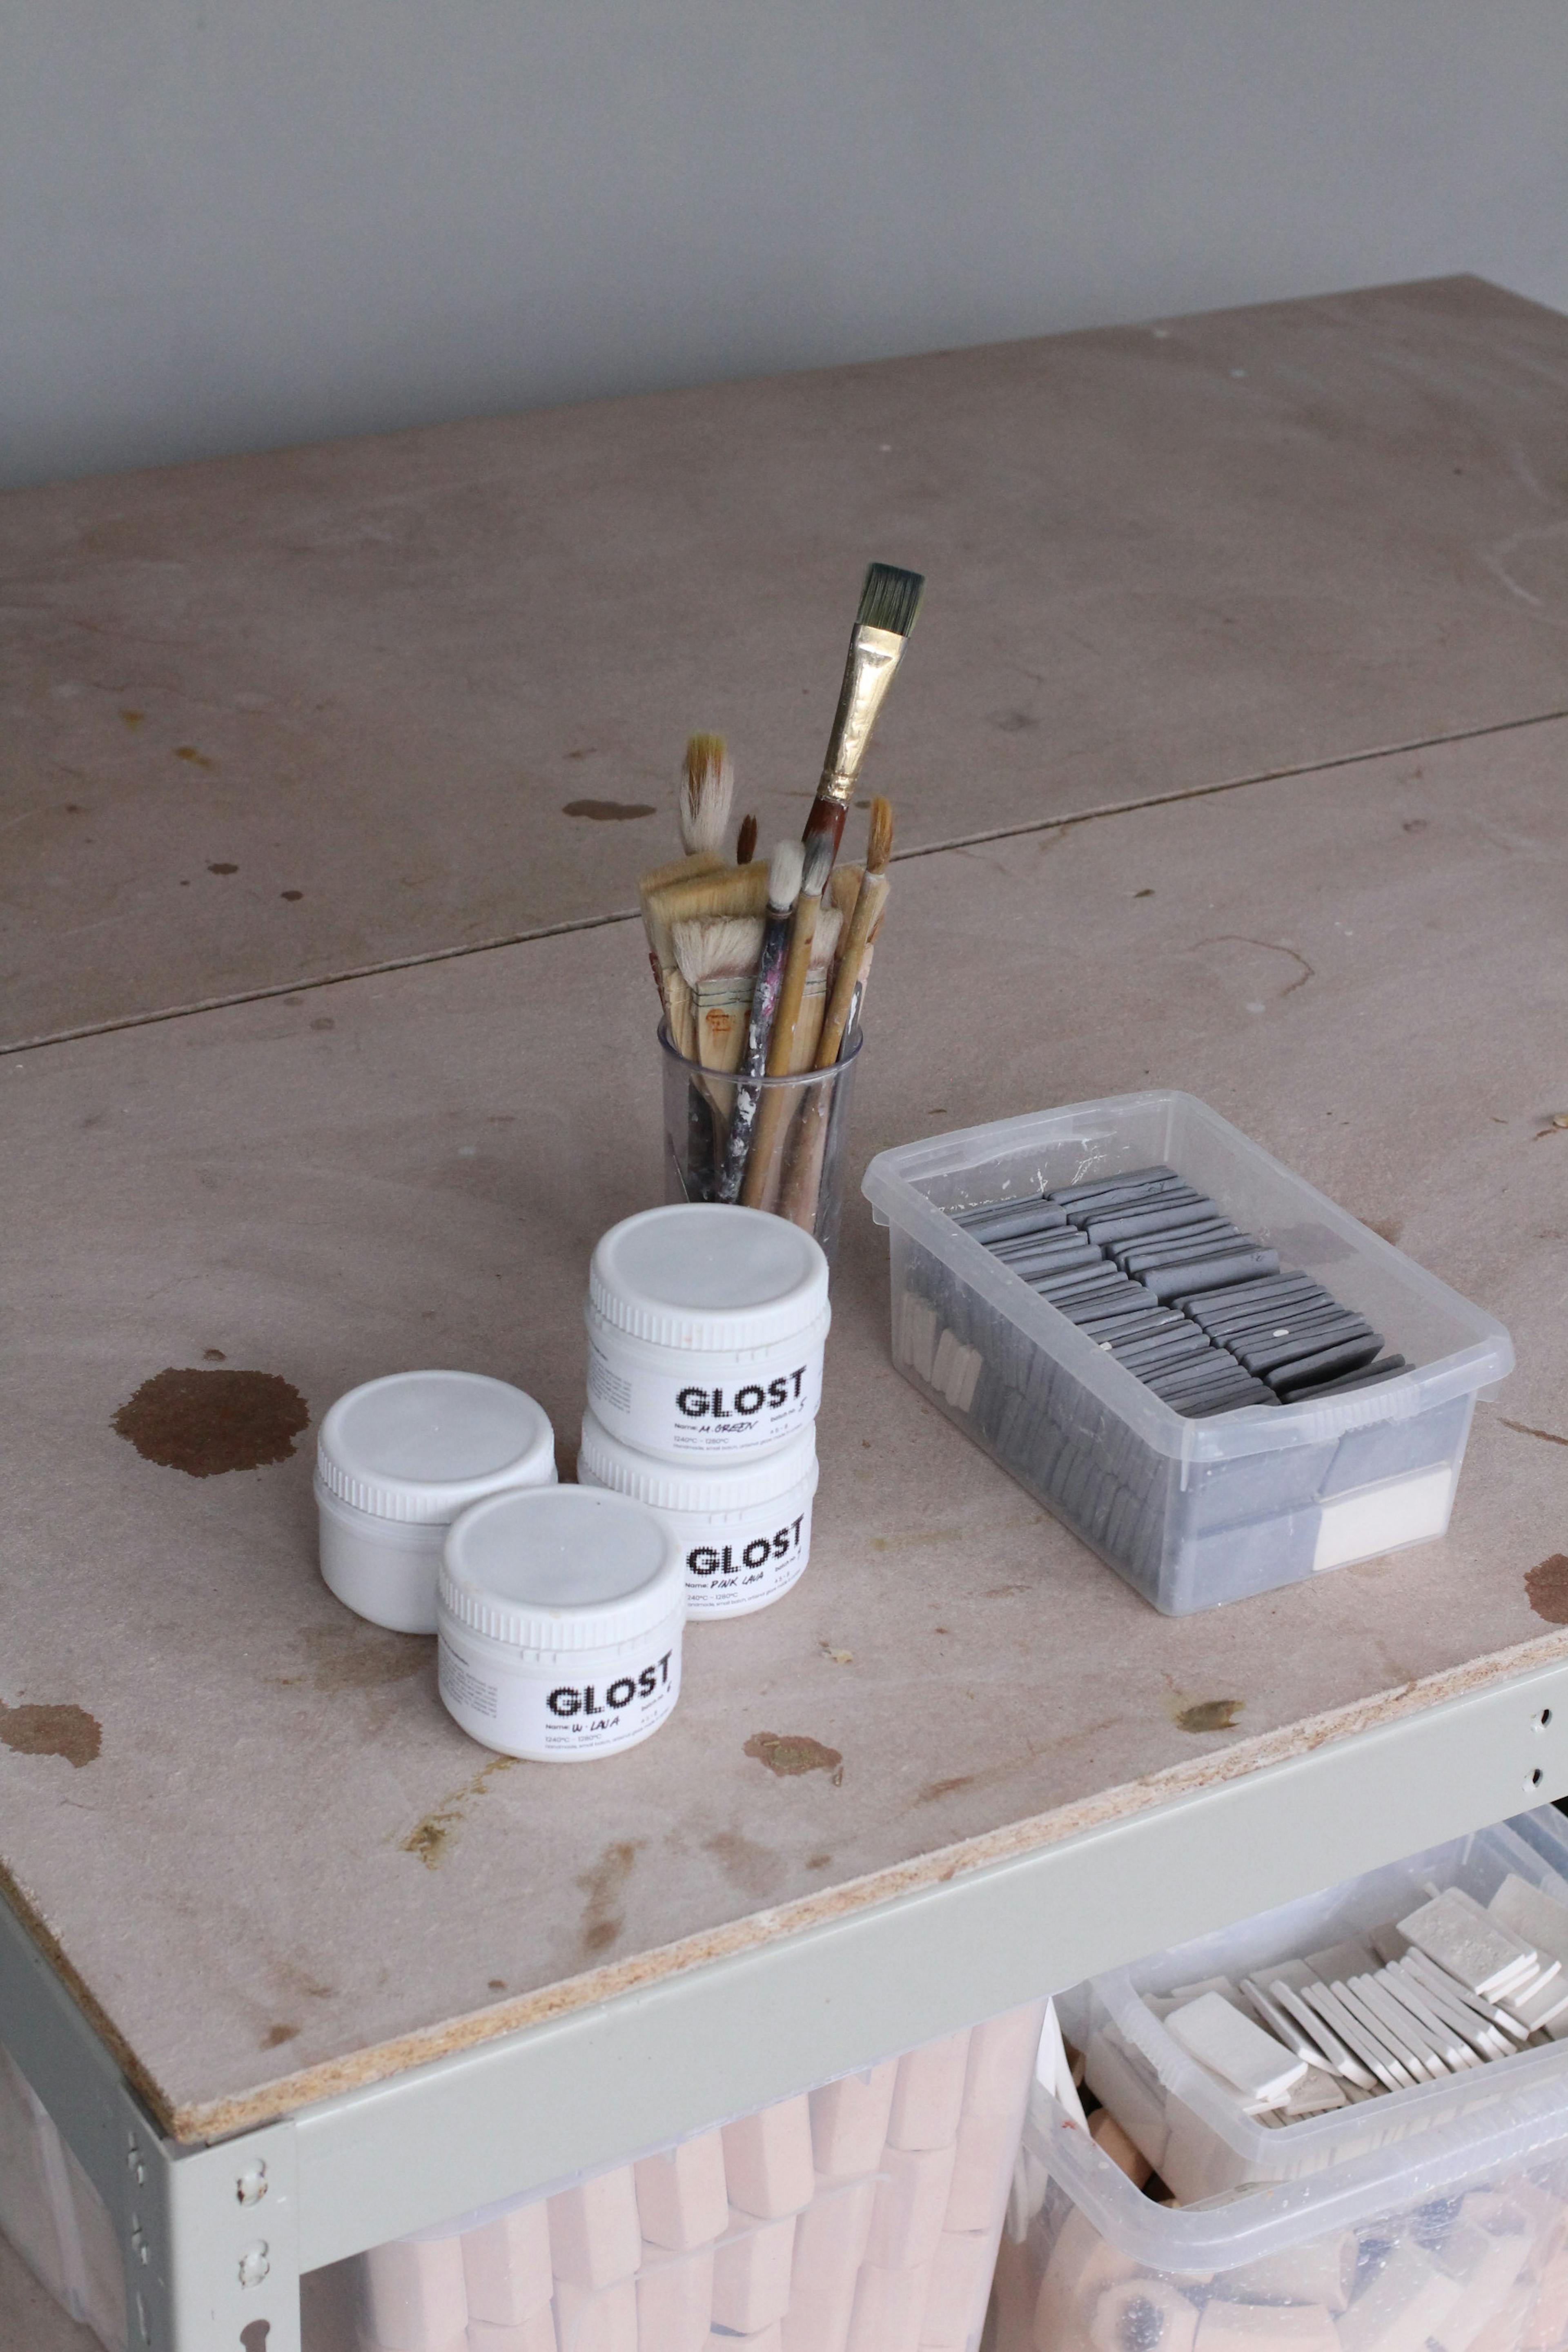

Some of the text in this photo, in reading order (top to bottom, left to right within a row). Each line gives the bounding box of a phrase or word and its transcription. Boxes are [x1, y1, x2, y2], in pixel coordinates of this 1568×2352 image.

[675, 1365, 807, 1419] GLOST
[715, 1421, 759, 1433] GREEN
[686, 1513, 804, 1577] GLOST
[710, 1577, 739, 1589] PINK
[741, 1571, 764, 1585] LAVA
[546, 1648, 673, 1717] GLOST
